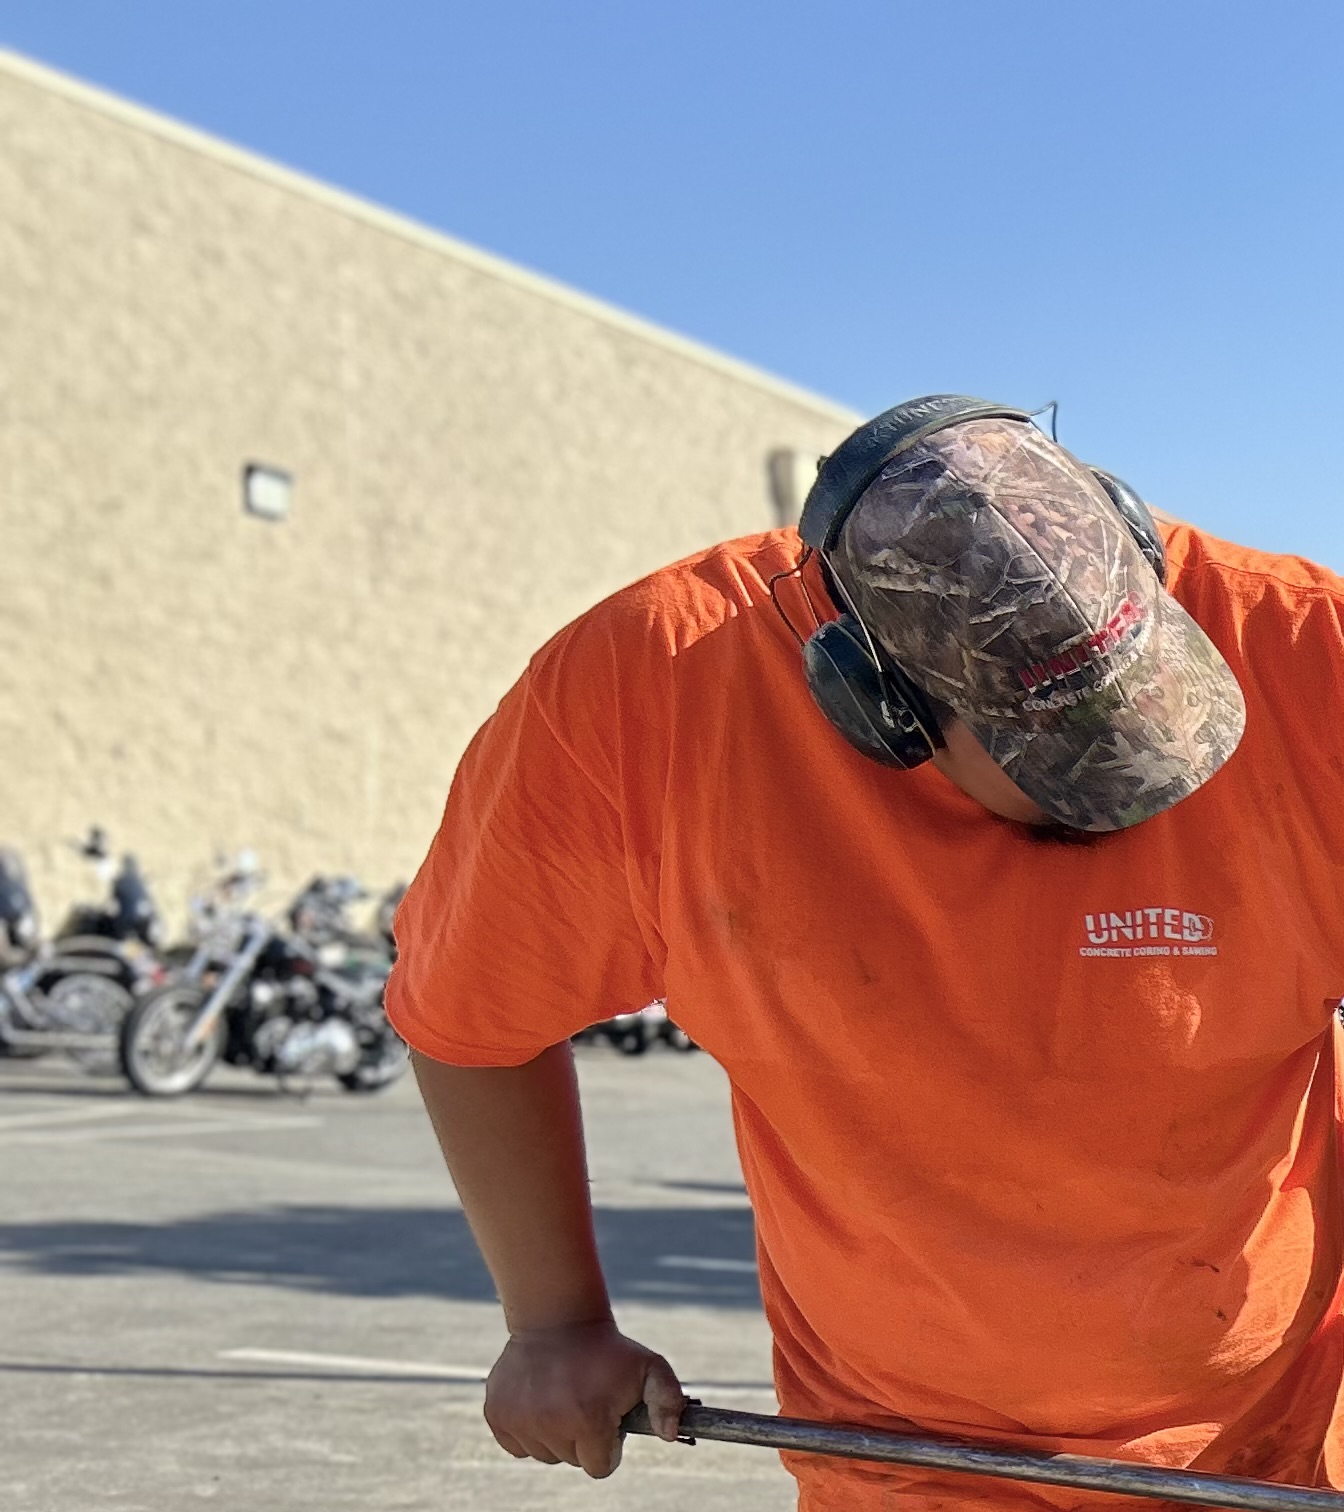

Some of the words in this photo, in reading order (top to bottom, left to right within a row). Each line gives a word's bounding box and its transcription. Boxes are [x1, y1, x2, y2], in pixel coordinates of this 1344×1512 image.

[1085, 908, 1204, 944] UNITED
[1080, 947, 1132, 957] CONCRETE
[1133, 946, 1170, 956] CORING
[1173, 946, 1180, 956] &
[1182, 946, 1217, 956] SAWING
